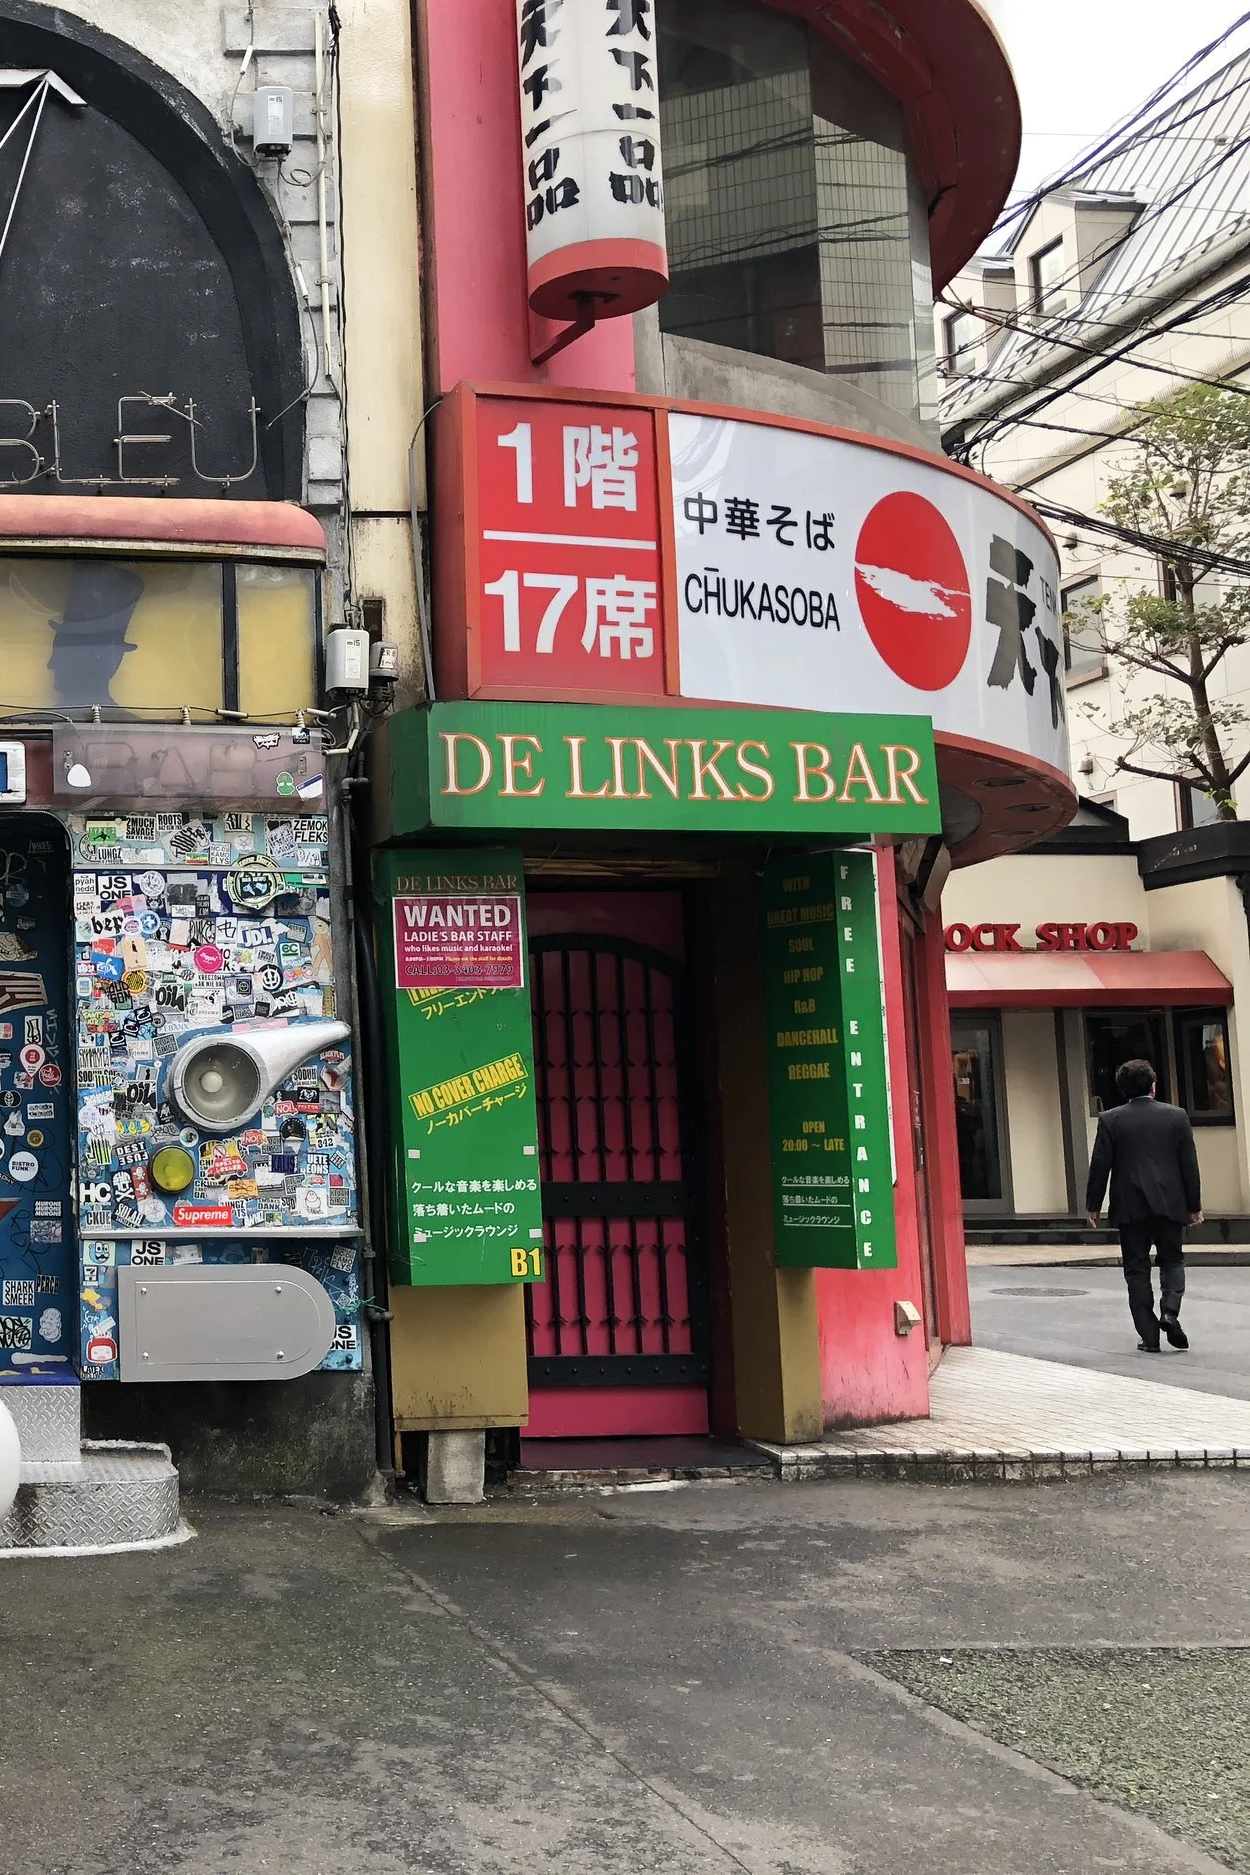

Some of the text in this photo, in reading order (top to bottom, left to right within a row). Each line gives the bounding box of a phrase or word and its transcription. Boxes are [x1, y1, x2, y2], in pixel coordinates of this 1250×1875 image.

[684, 491, 836, 551] 中華そば
[483, 569, 658, 661] 17席
[438, 732, 930, 806] DE LINKS BAR
[157, 814, 182, 826] ROOTS
[293, 820, 328, 831] ZEMOK
[294, 831, 328, 843] FLEKS
[102, 876, 128, 890] JS
[397, 874, 518, 891] DE LINKS BAR
[99, 890, 131, 900] ONE
[403, 905, 511, 927] WANTED
[404, 930, 512, 942] LADIE'S BAR STAFF
[1035, 922, 1139, 951] SHOP
[404, 944, 421, 952] who
[422, 944, 440, 952] likes
[441, 944, 463, 952] music
[464, 944, 479, 952] and
[788, 938, 814, 953] SOUL
[783, 966, 824, 984] HIP HOP
[794, 999, 816, 1014] R&B
[776, 1028, 839, 1047] DANCEHALL
[787, 1062, 831, 1080] REGGAE
[412, 1055, 525, 1117] NO COVER CHARGE
[426, 1083, 527, 1135] ノーカバーチャージ
[802, 1120, 826, 1134] OPEN
[782, 1138, 845, 1152] 20:00 LATE
[79, 1182, 111, 1202] HC
[411, 1178, 537, 1194] クールな音楽を楽しめる
[177, 1207, 229, 1221] Supreme
[412, 1202, 515, 1218] 落ち着いたムードの
[414, 1224, 518, 1239] ミュージックラウンジ
[135, 1241, 162, 1255] JS
[131, 1255, 165, 1265] ONE
[510, 1247, 541, 1277] B1
[4, 1280, 34, 1294] SHARK
[4, 1292, 34, 1306] SMEER
